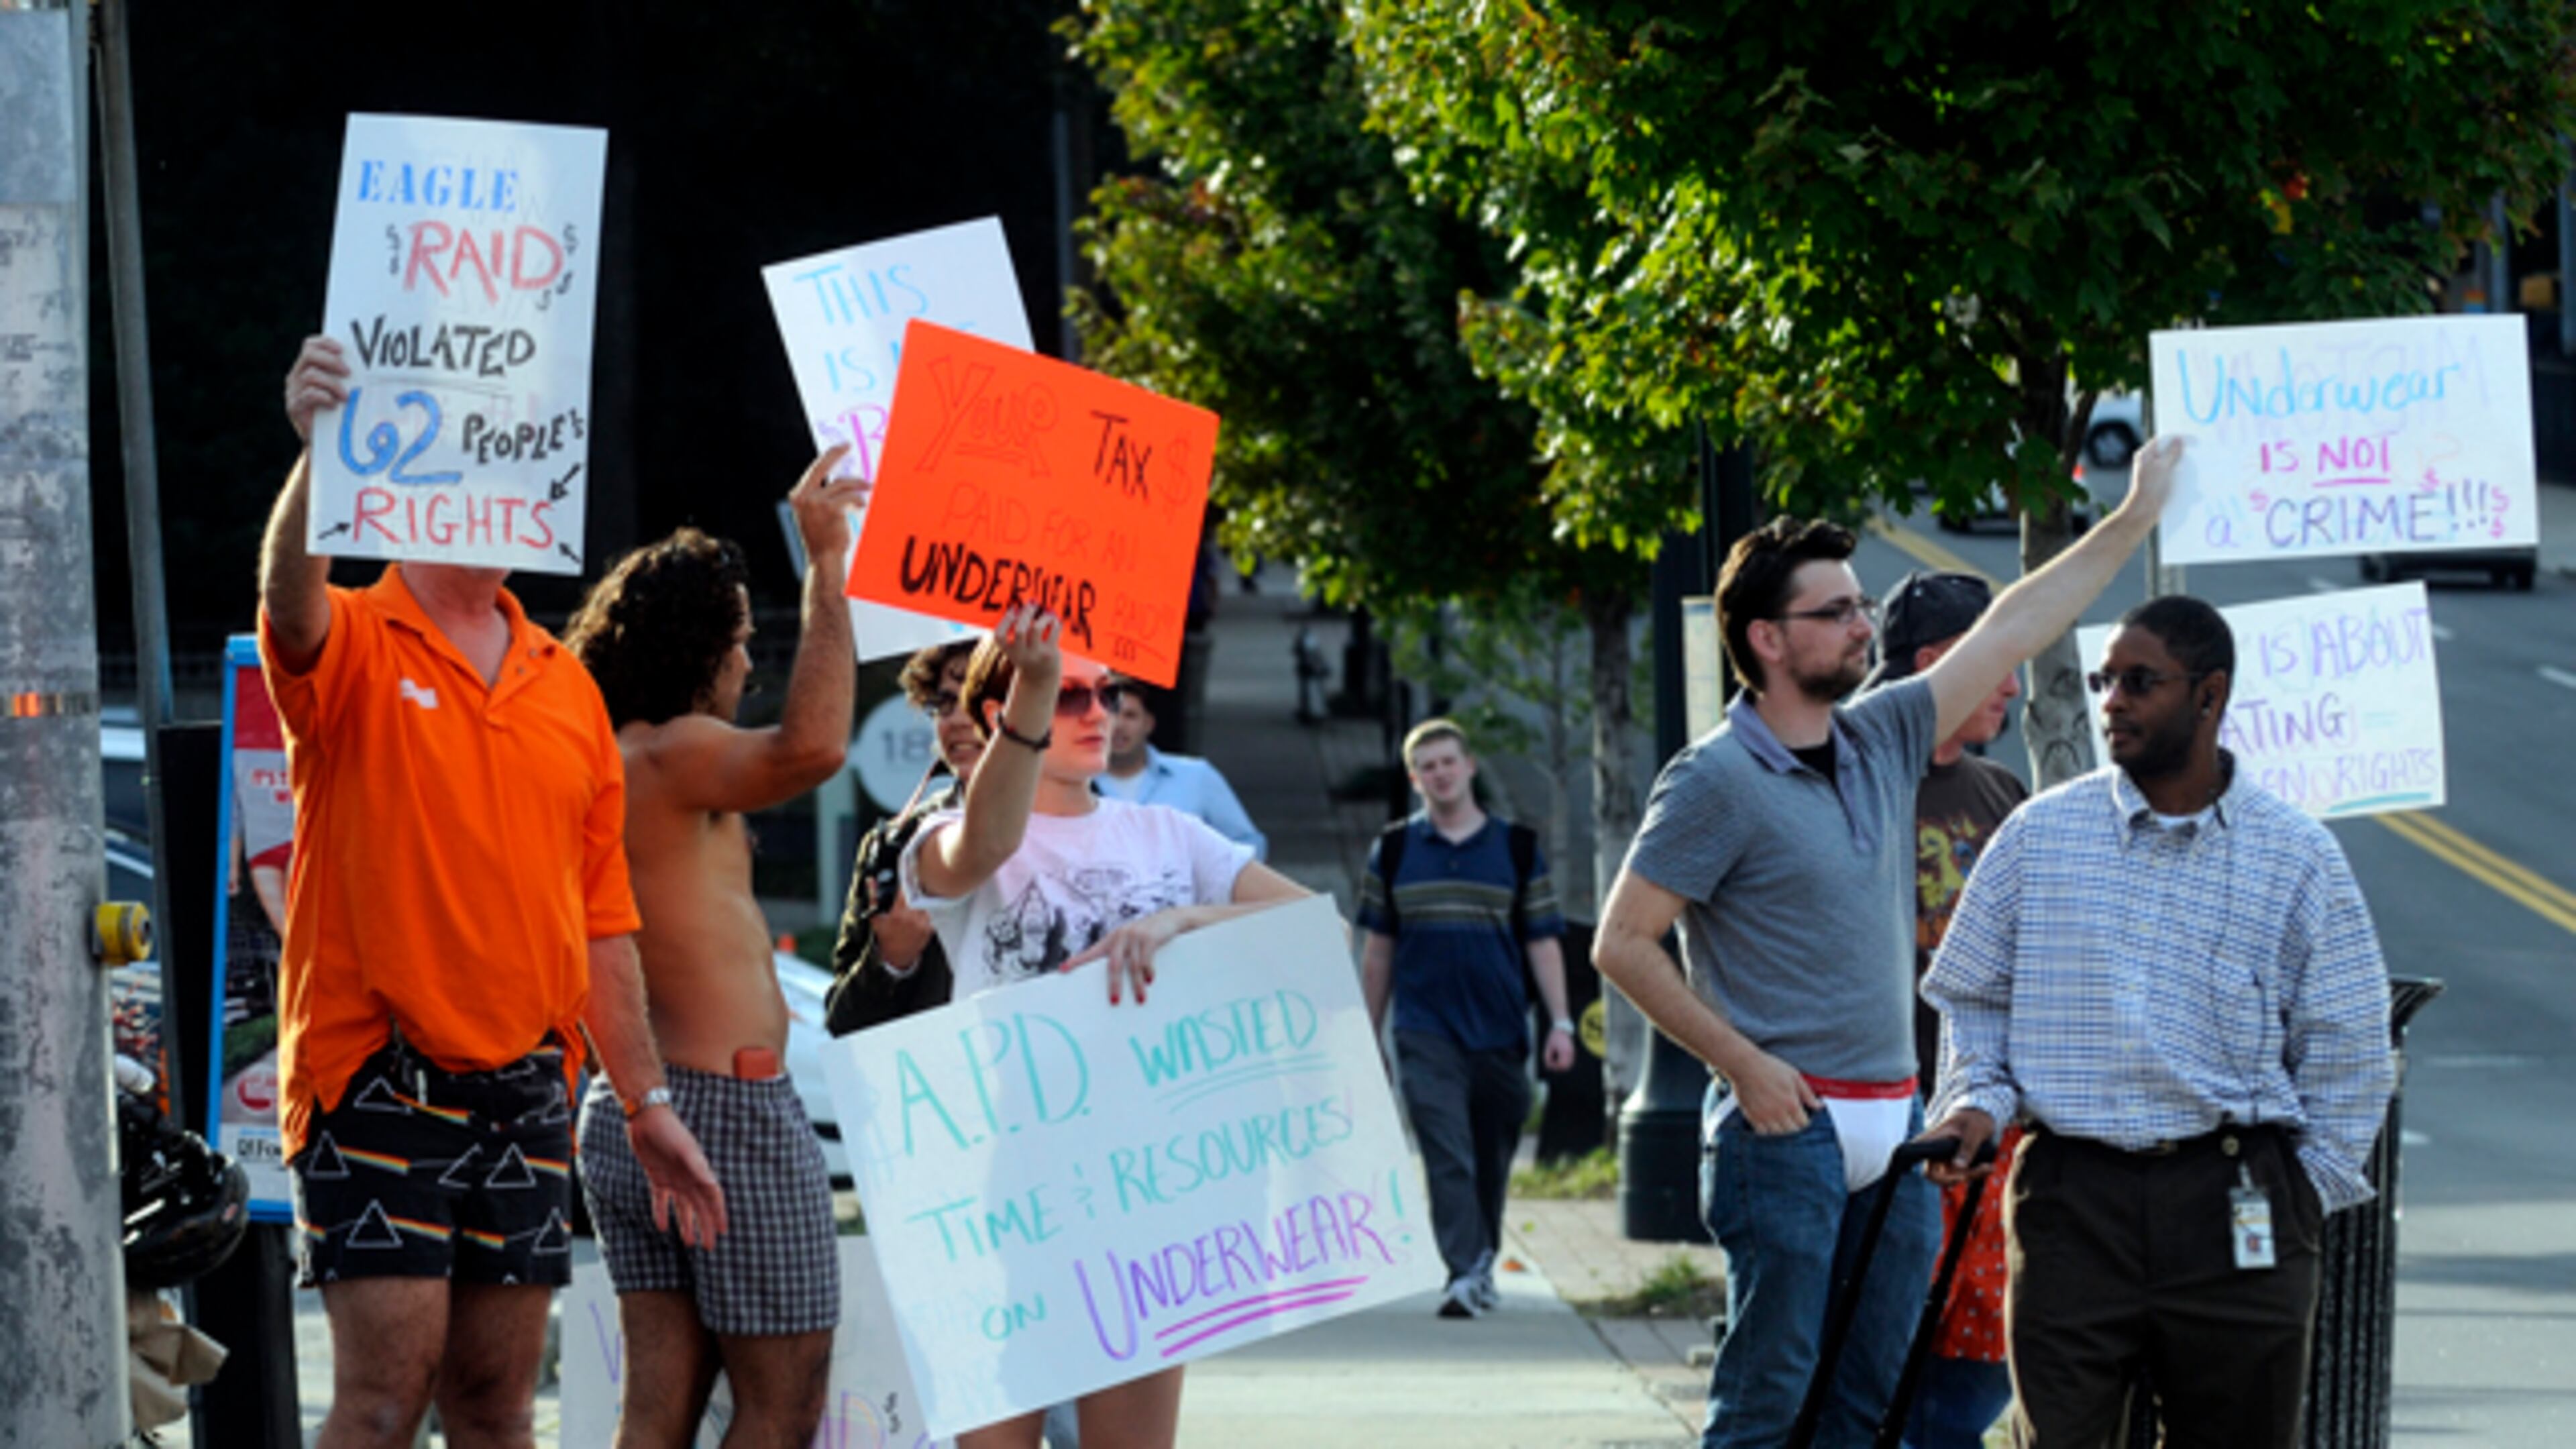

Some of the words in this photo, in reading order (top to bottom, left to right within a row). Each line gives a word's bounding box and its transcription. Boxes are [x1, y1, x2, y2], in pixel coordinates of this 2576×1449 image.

[358, 161, 518, 211] EAGLE
[402, 220, 564, 306] RAID
[793, 263, 929, 327] THIS
[350, 314, 537, 376] VIOLATED
[824, 346, 876, 393] IS
[338, 388, 463, 484] 62
[1089, 409, 1152, 500] TAX
[2261, 440, 2300, 472] IS
[2318, 435, 2391, 472] NOT
[353, 487, 553, 549] RIGHTS
[2259, 631, 2298, 679] IS
[2312, 608, 2428, 678] ABOUT
[2219, 691, 2348, 758] ATING
[895, 1012, 1091, 1158] A.P.D.
[1128, 989, 1318, 1087] WASTED
[905, 1186, 1063, 1263] TIME
[1108, 1095, 1355, 1214] RESOURCES
[979, 1292, 1046, 1342] ON
